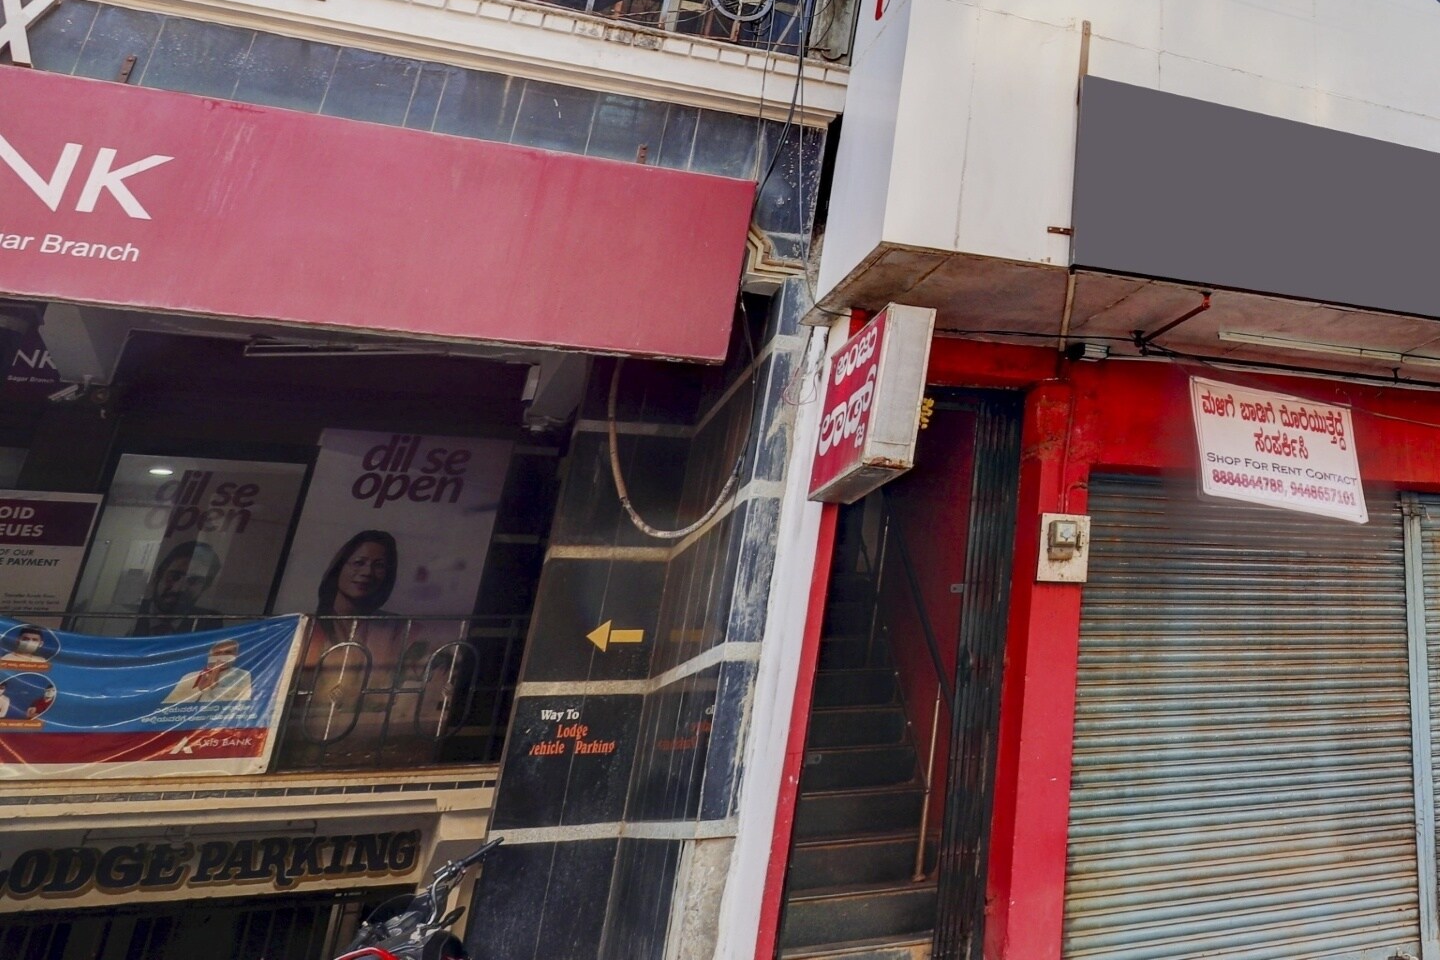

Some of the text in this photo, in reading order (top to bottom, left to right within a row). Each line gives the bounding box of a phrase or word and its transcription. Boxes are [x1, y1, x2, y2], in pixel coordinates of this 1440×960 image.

[39, 233, 140, 262] Branch
[835, 326, 878, 386] ಅಂಜು
[1240, 401, 1276, 424] ಬಾಡಿಗೆ
[362, 435, 473, 475] dil se
[211, 481, 260, 508] se
[352, 472, 465, 508] open
[7, 558, 60, 567] PAYMENT
[541, 708, 580, 722] Way To
[556, 723, 588, 740] Lodge
[575, 740, 615, 755] Parking
[0, 831, 421, 896] ODGE PARKING
